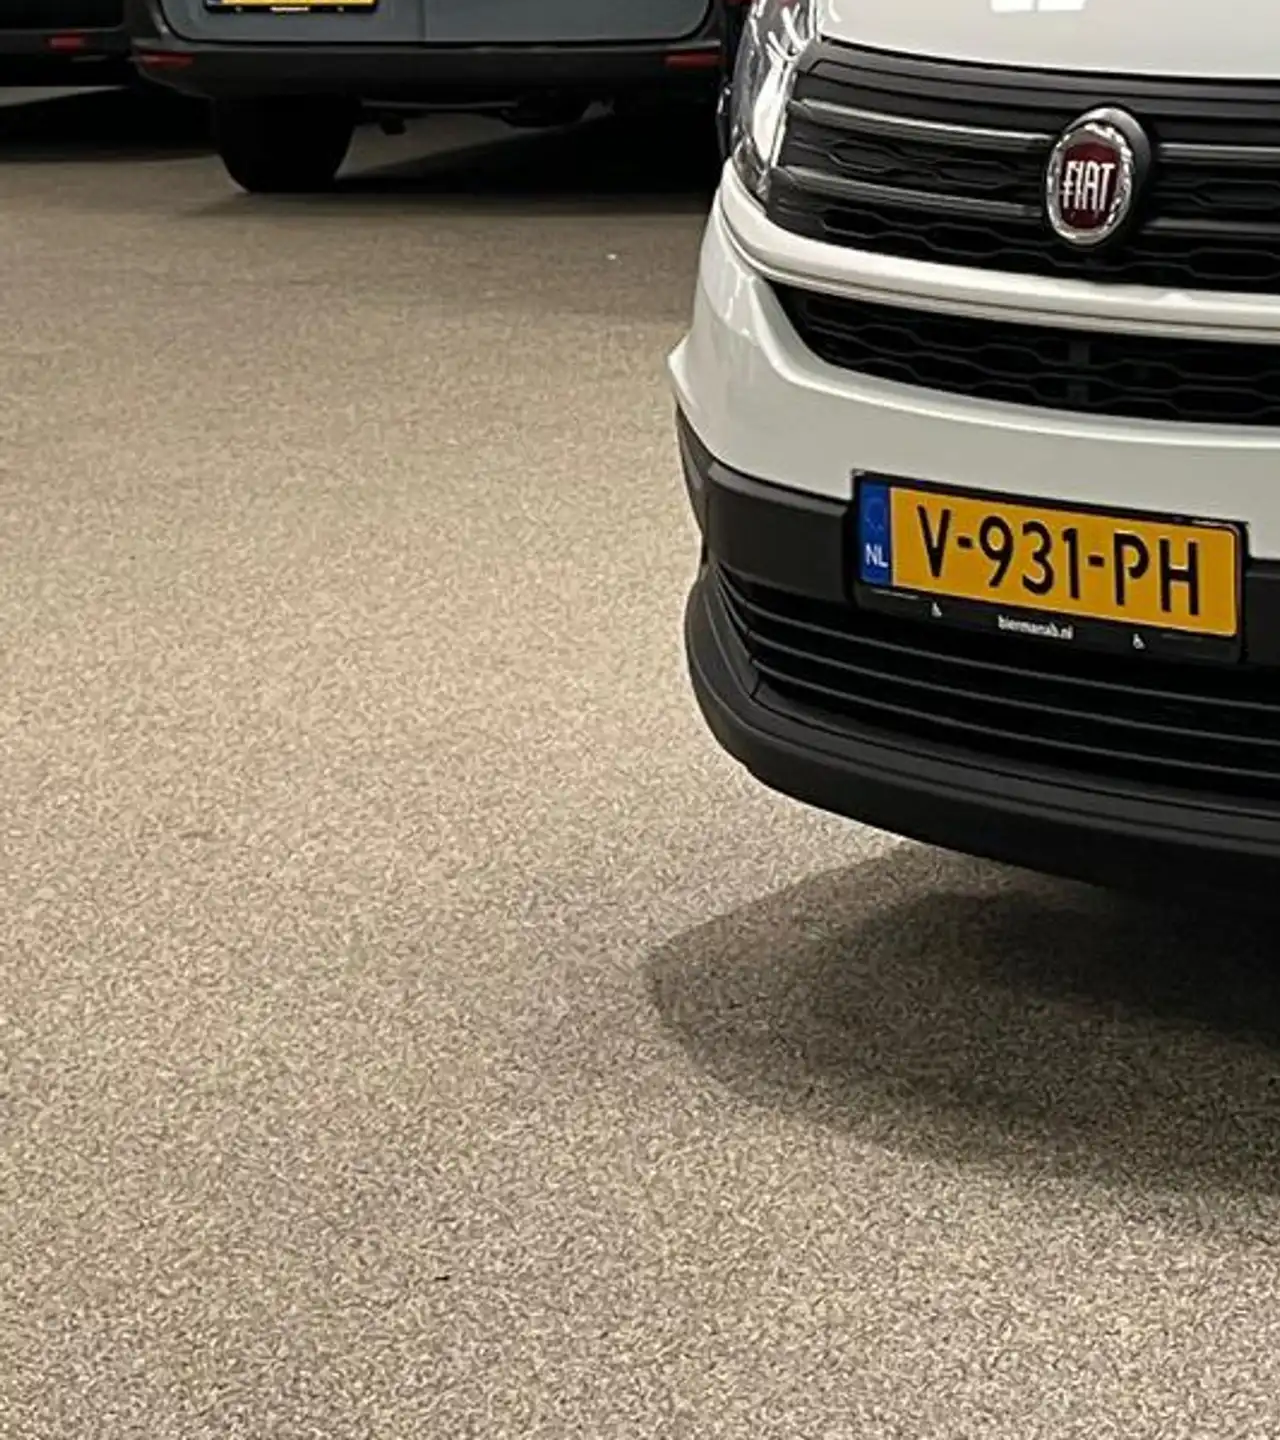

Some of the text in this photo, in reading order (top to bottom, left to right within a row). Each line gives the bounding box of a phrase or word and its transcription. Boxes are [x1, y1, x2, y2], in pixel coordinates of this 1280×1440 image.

[1061, 160, 1116, 212] FIAT
[865, 542, 889, 568] NL
[916, 504, 1200, 616] V-931-PH
